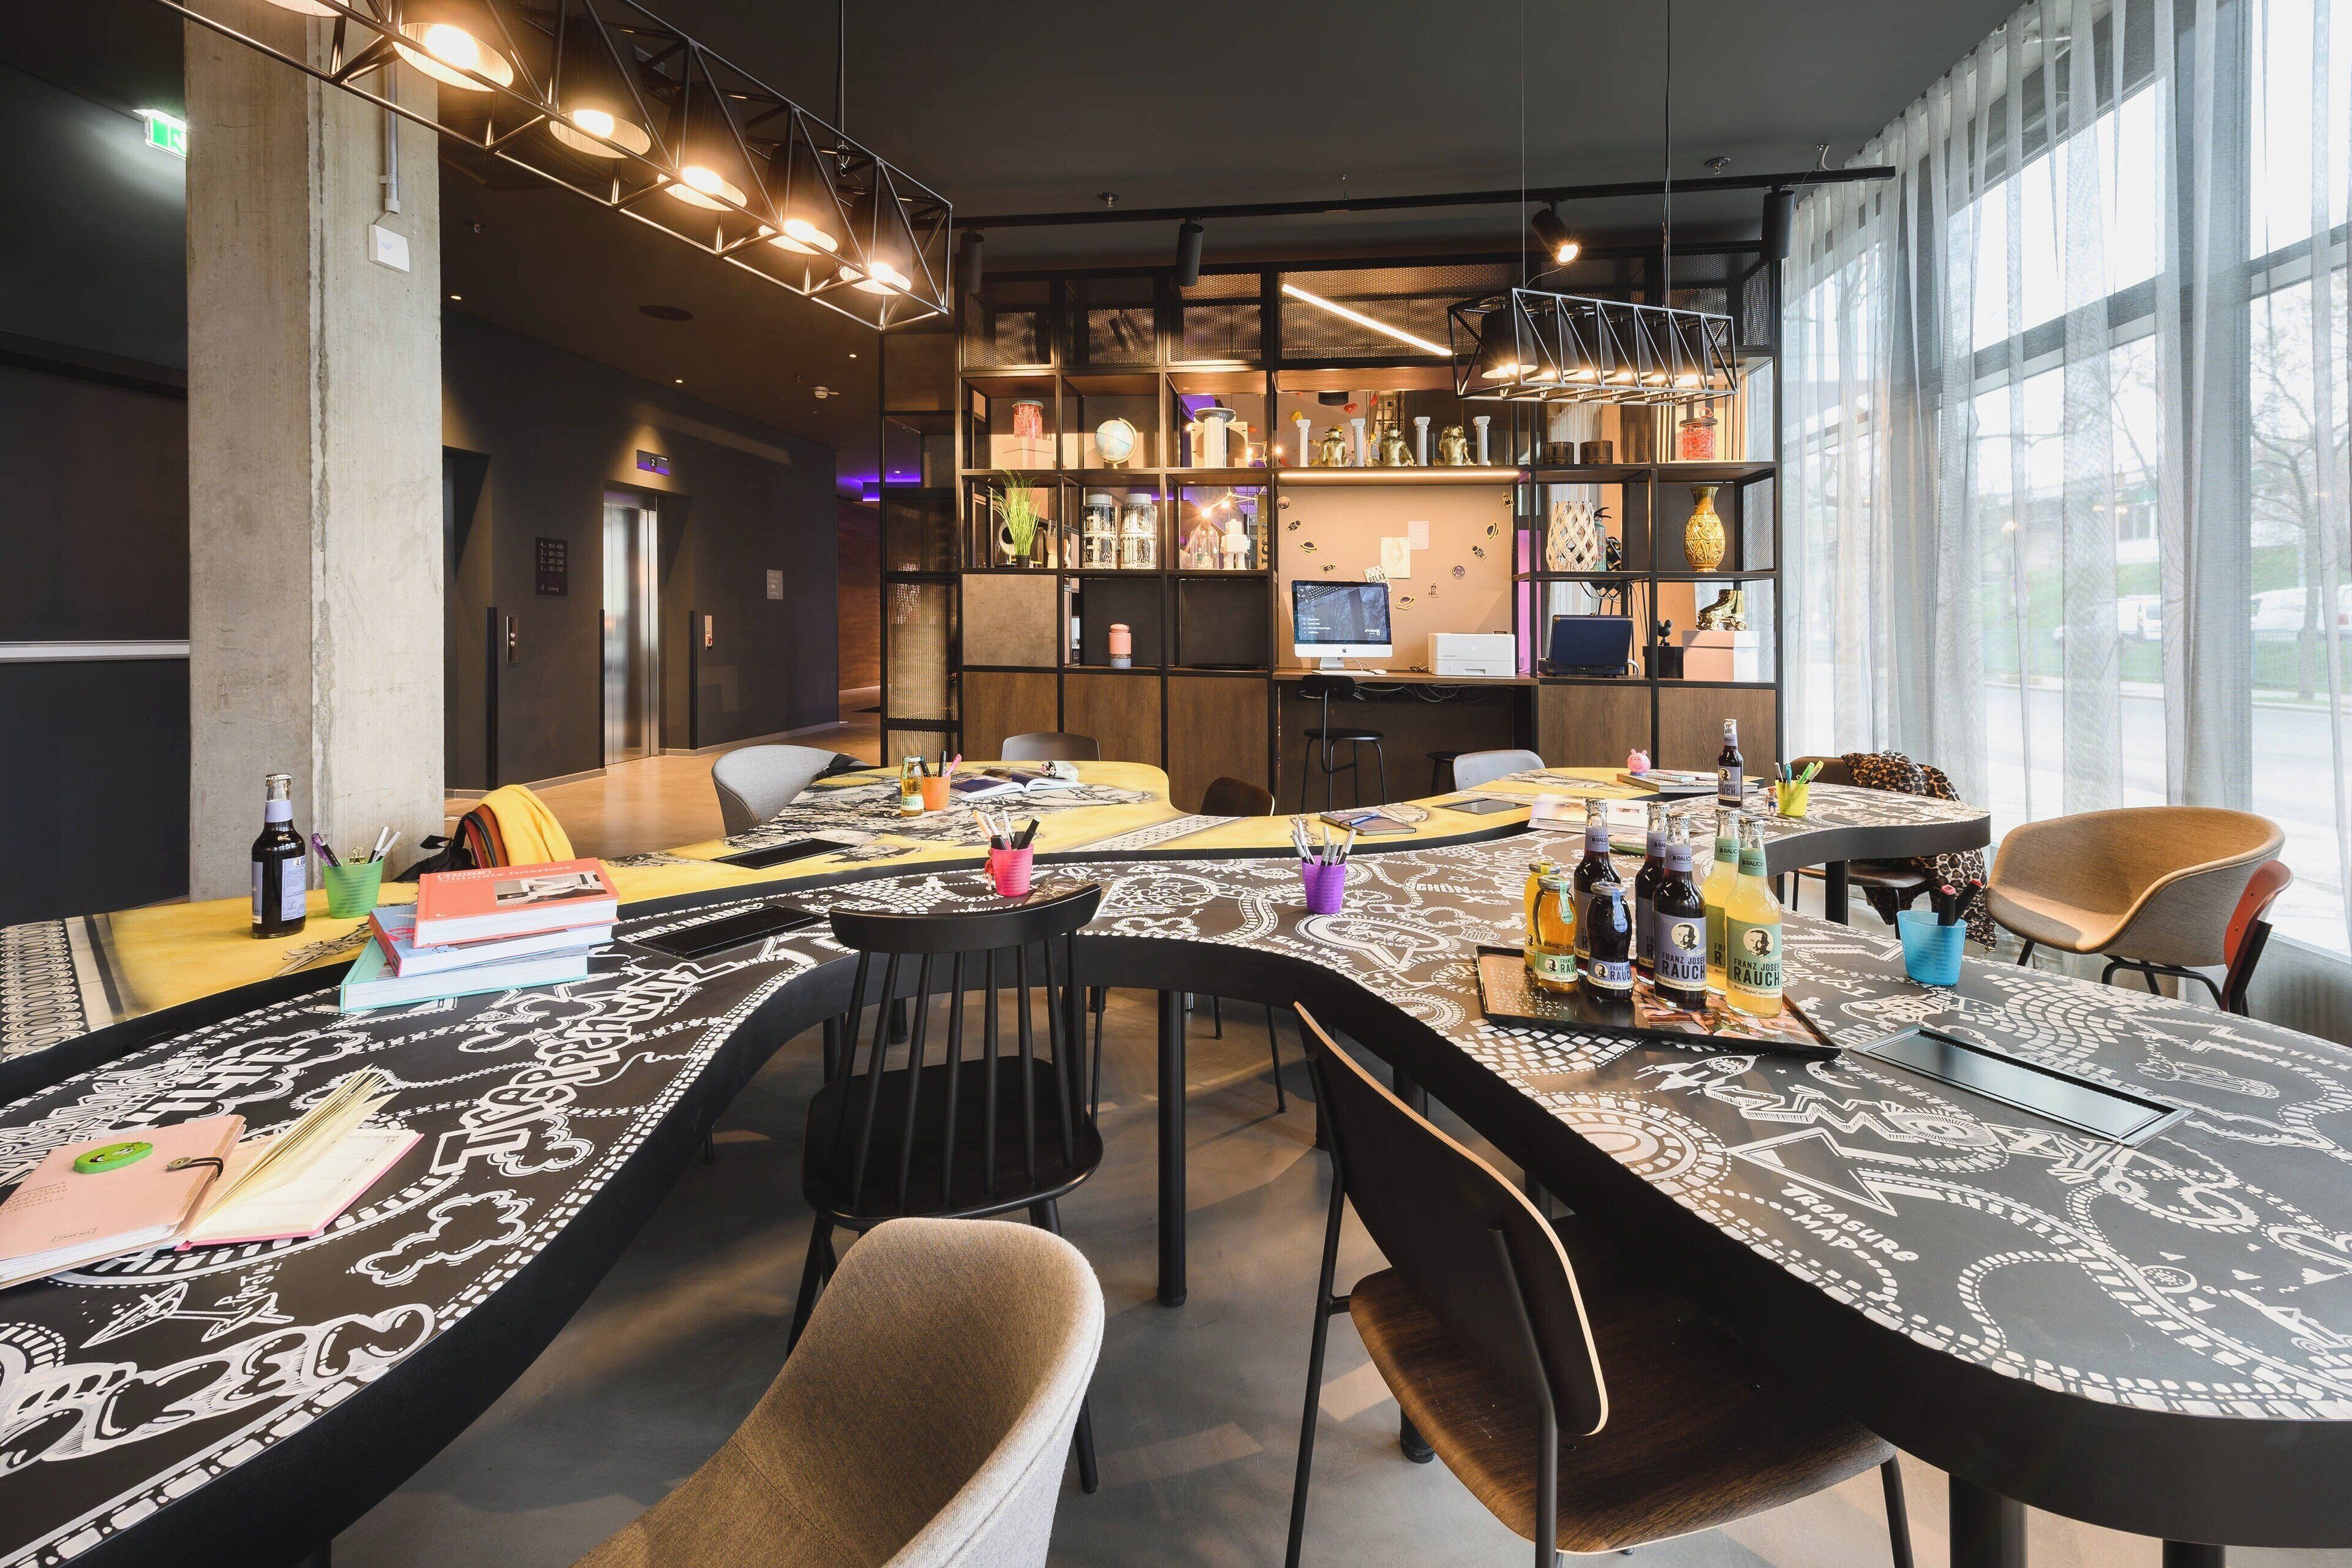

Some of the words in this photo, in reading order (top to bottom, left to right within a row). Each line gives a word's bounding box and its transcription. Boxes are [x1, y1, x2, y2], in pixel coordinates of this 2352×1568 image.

[1368, 573, 1387, 583] RELAX
[509, 865, 572, 875] Interiors
[1662, 951, 1684, 964] FRANZ
[1687, 956, 1706, 965] JOSEF
[1734, 957, 1757, 970] FRANZ
[1760, 963, 1779, 971] JOSEF
[1560, 964, 1577, 973] RAUC
[1662, 960, 1706, 980] RAUCH
[1610, 970, 1631, 981] RAUC
[1734, 965, 1779, 987] RAUCH
